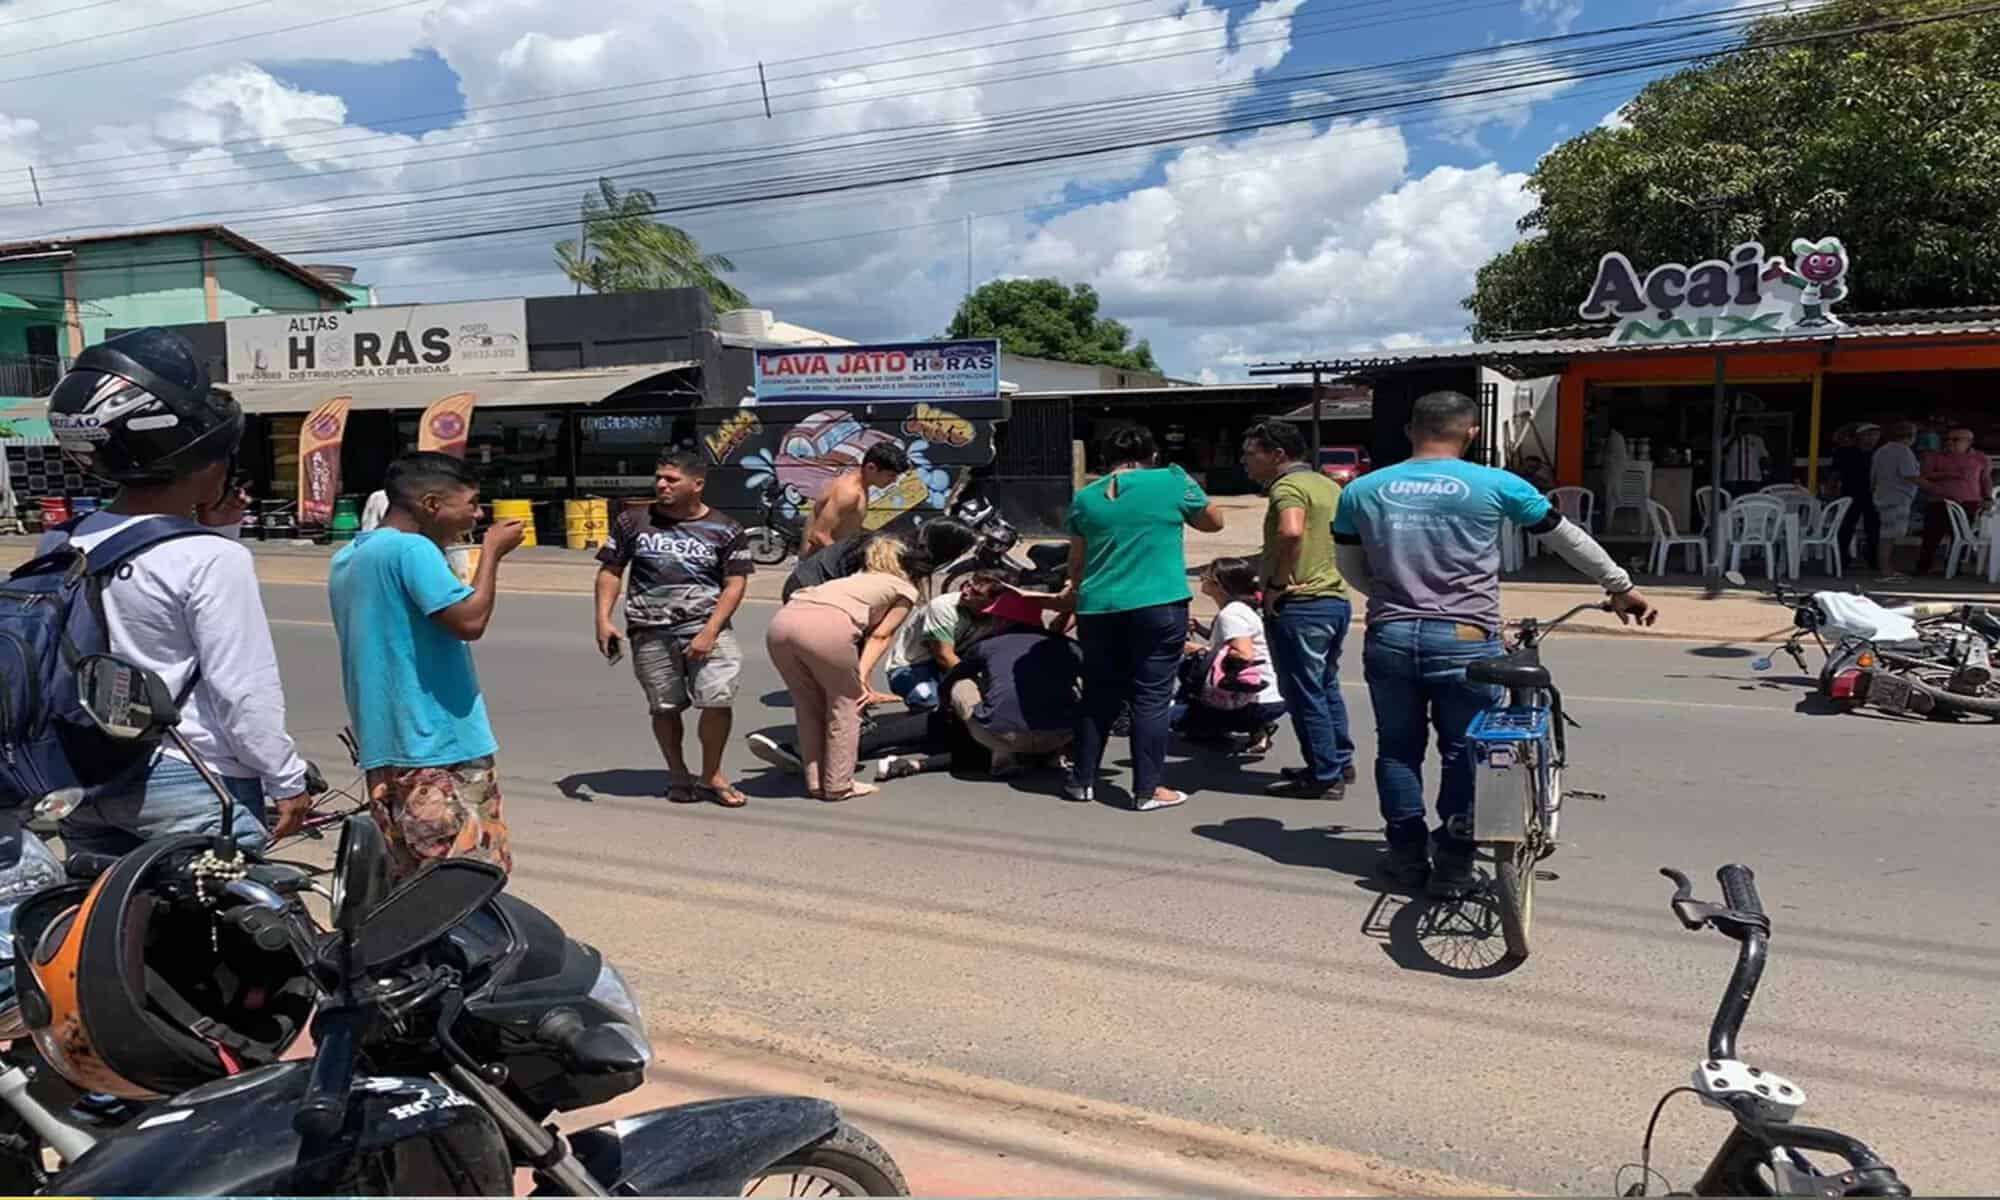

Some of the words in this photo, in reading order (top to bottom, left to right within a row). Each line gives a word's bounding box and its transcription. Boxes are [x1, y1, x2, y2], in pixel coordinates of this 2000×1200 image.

[288, 316, 338, 332] ALTAS
[1617, 312, 1785, 341] MIX
[760, 355, 829, 375] LAVA
[837, 352, 906, 374] JATO
[1389, 478, 1459, 495] UNIÃO
[637, 532, 716, 558] Alaska
